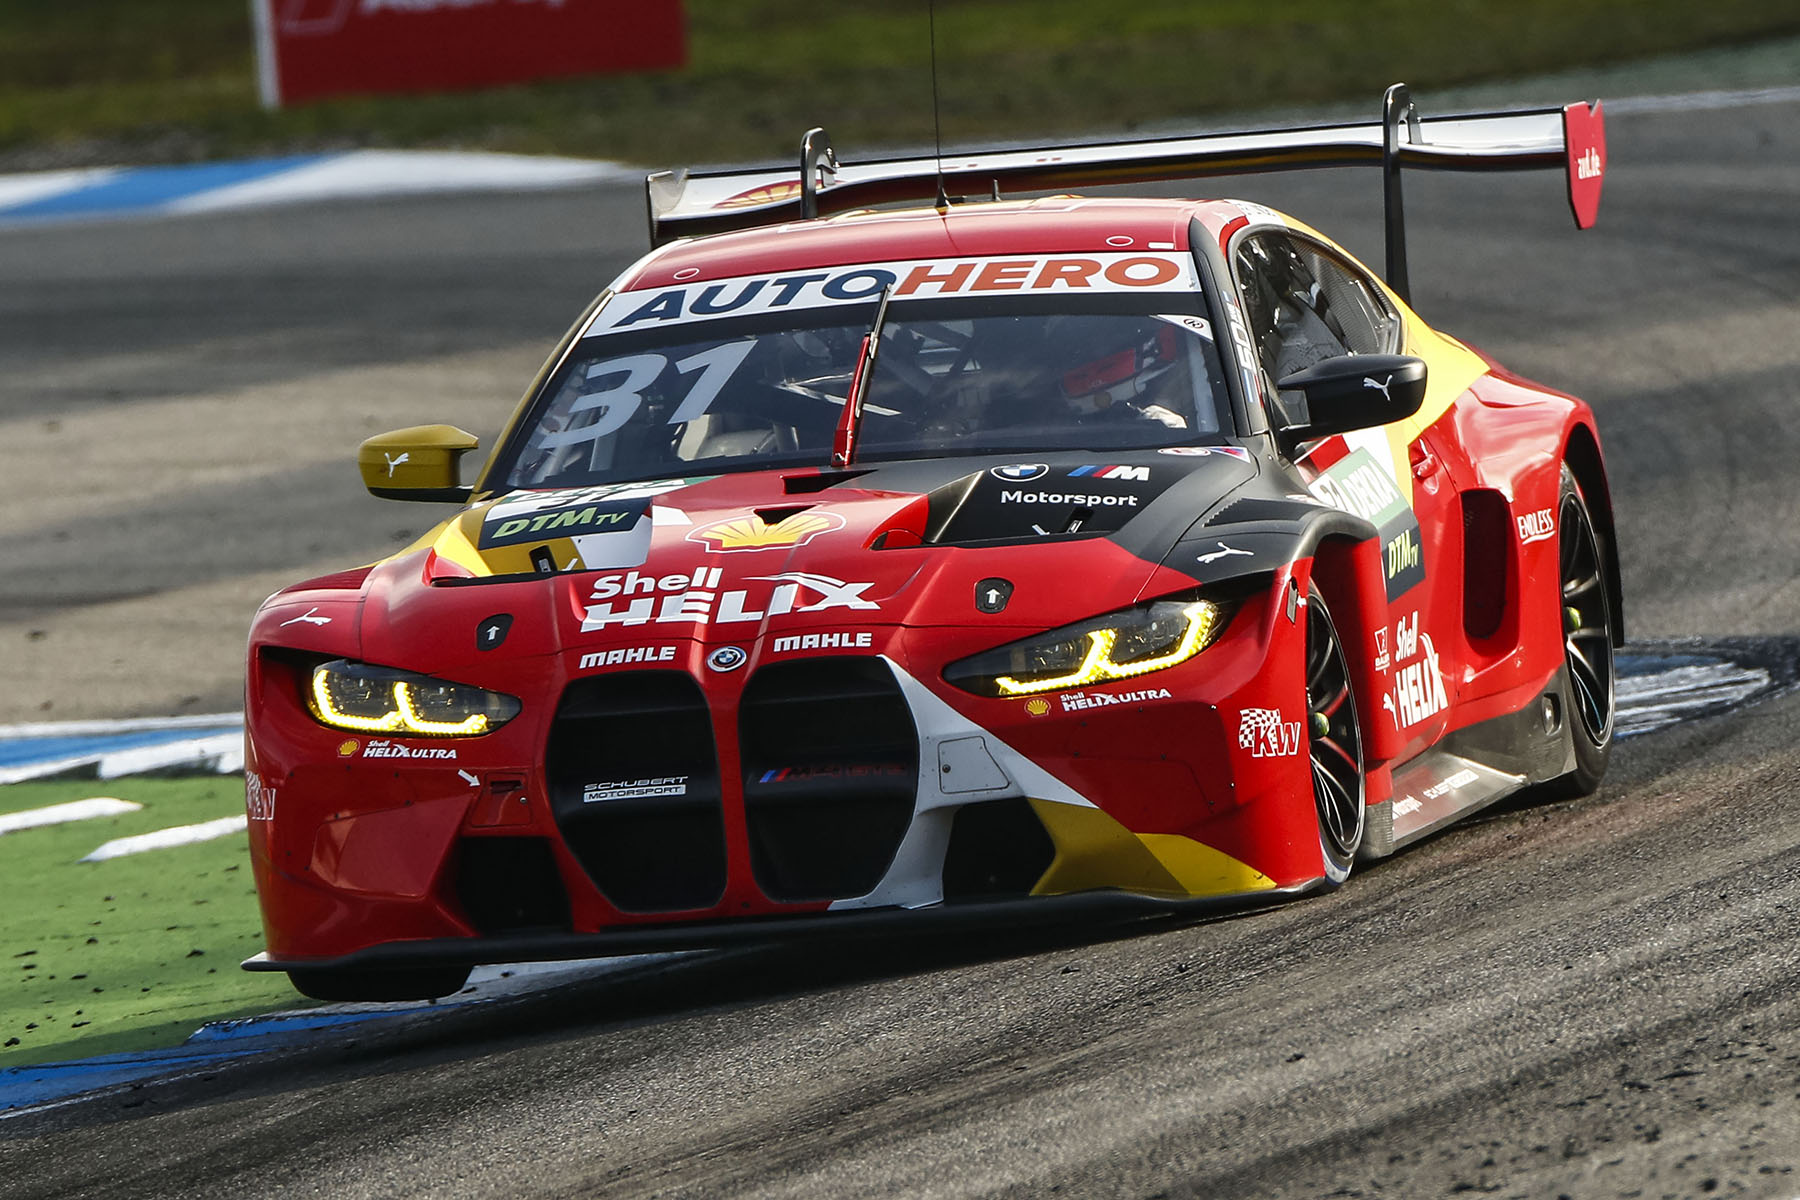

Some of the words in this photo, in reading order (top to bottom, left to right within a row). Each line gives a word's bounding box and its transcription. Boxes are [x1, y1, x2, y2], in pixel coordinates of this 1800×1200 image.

[538, 340, 758, 449] 31
[1000, 490, 1138, 507] Motorsport
[491, 507, 598, 539] DTM
[595, 512, 629, 526] TV
[1517, 508, 1555, 540] ENDLESS
[1387, 529, 1411, 579] DTM
[590, 566, 723, 599] Shell
[580, 571, 881, 633] HELIX
[773, 632, 873, 653] MAHLE
[1395, 610, 1419, 663] Shell
[579, 646, 676, 669] MAHLE
[1395, 632, 1449, 729] HELIX
[1060, 692, 1085, 702] Shell
[1252, 722, 1302, 758] KW
[584, 776, 689, 791] SCHUBERT
[588, 786, 681, 800] MOTORSPORT
